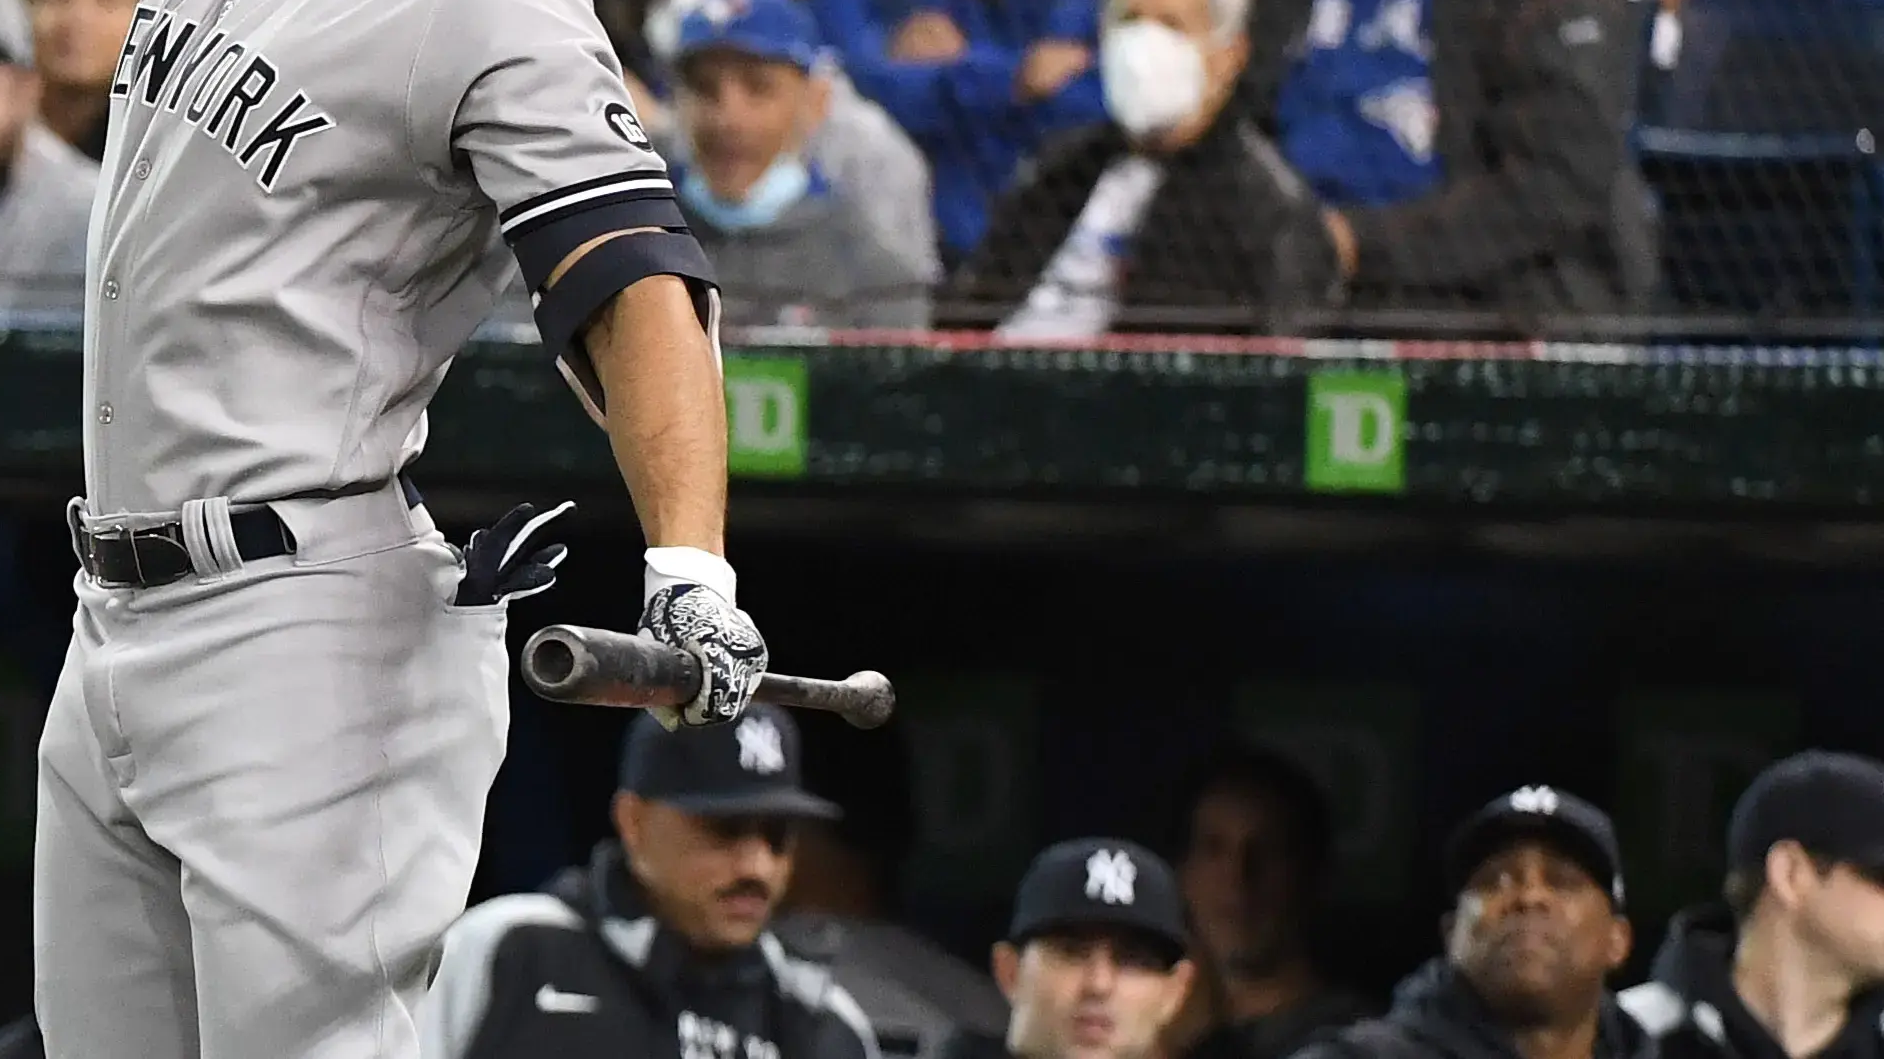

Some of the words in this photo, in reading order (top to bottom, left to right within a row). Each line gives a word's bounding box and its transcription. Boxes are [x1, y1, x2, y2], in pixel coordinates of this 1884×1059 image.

[163, 27, 338, 195] YORK
[609, 112, 648, 143] 16
[1314, 392, 1394, 464] TD
